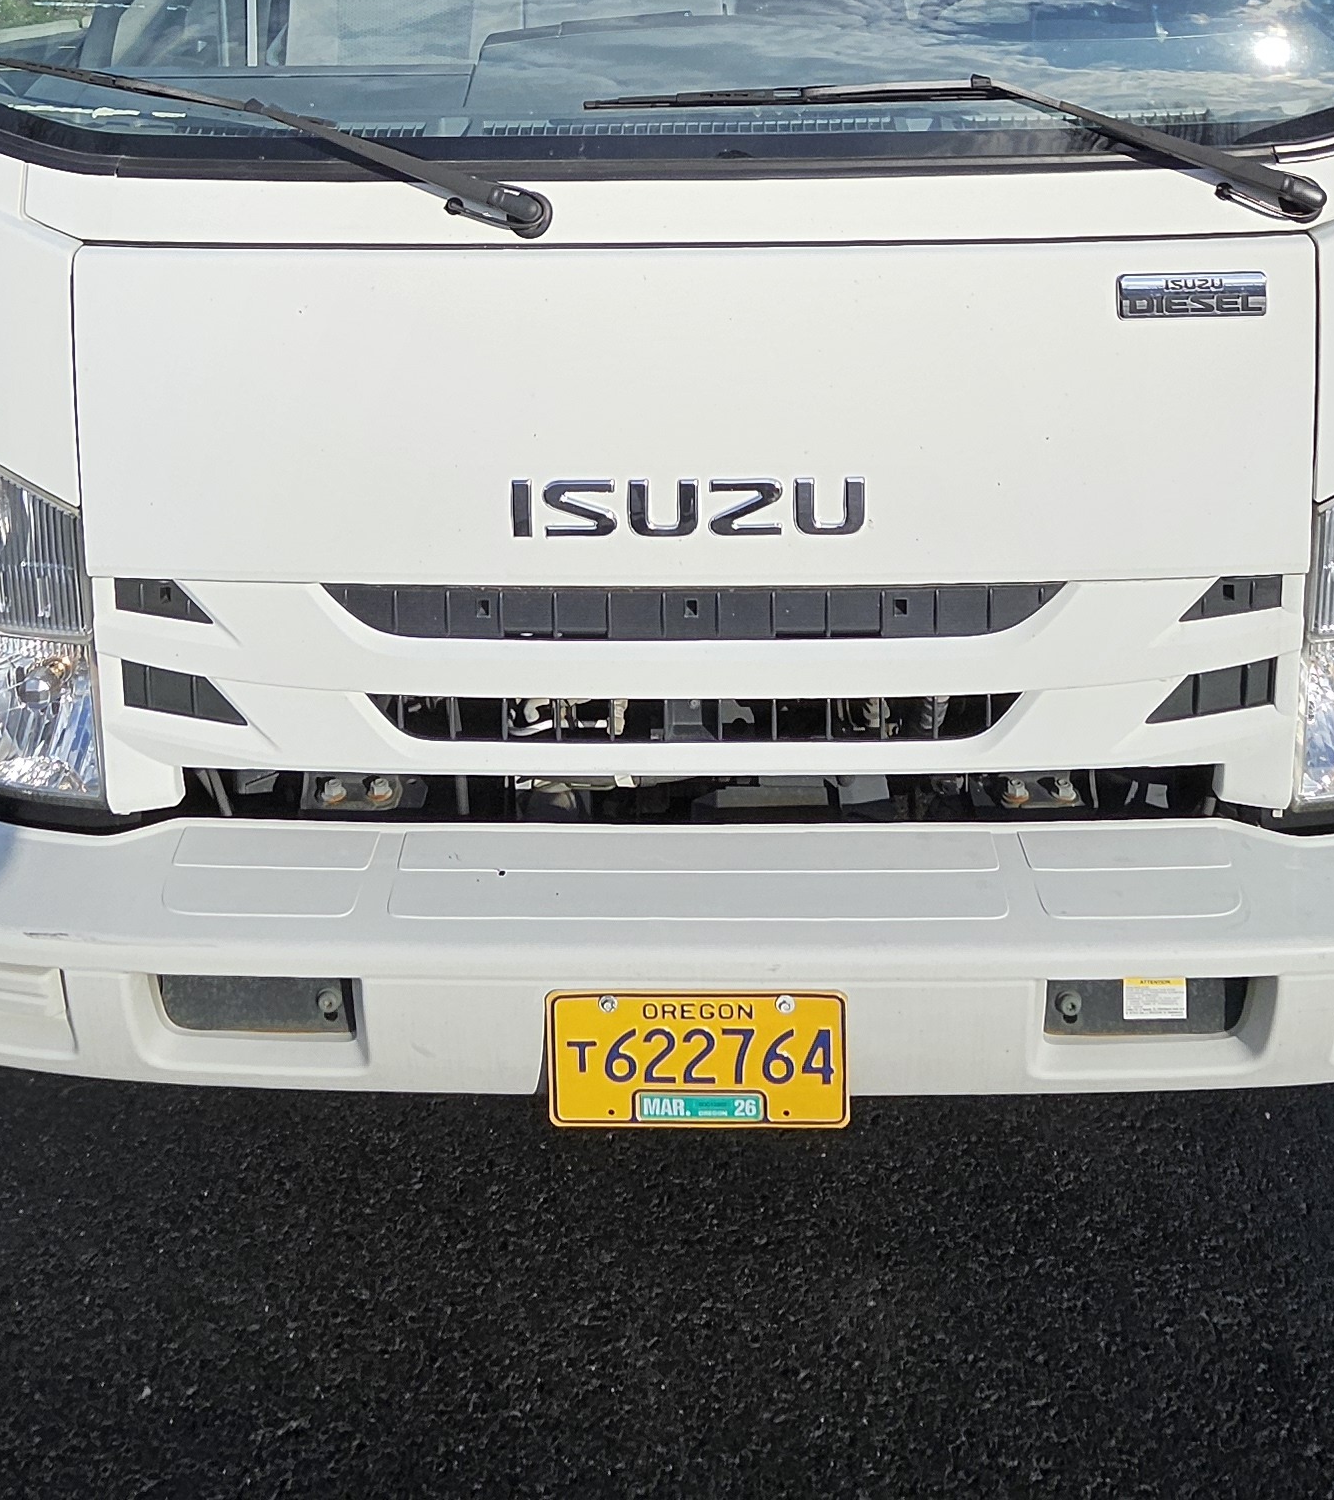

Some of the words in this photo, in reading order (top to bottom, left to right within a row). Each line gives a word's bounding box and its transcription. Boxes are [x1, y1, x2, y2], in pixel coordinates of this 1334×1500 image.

[1163, 278, 1224, 291] ISUZU
[1124, 293, 1263, 315] DIESEL
[511, 477, 865, 538] ISUZU
[642, 1003, 754, 1020] OREGON
[643, 1098, 691, 1116] MAR.
[733, 1099, 757, 1117] 26
